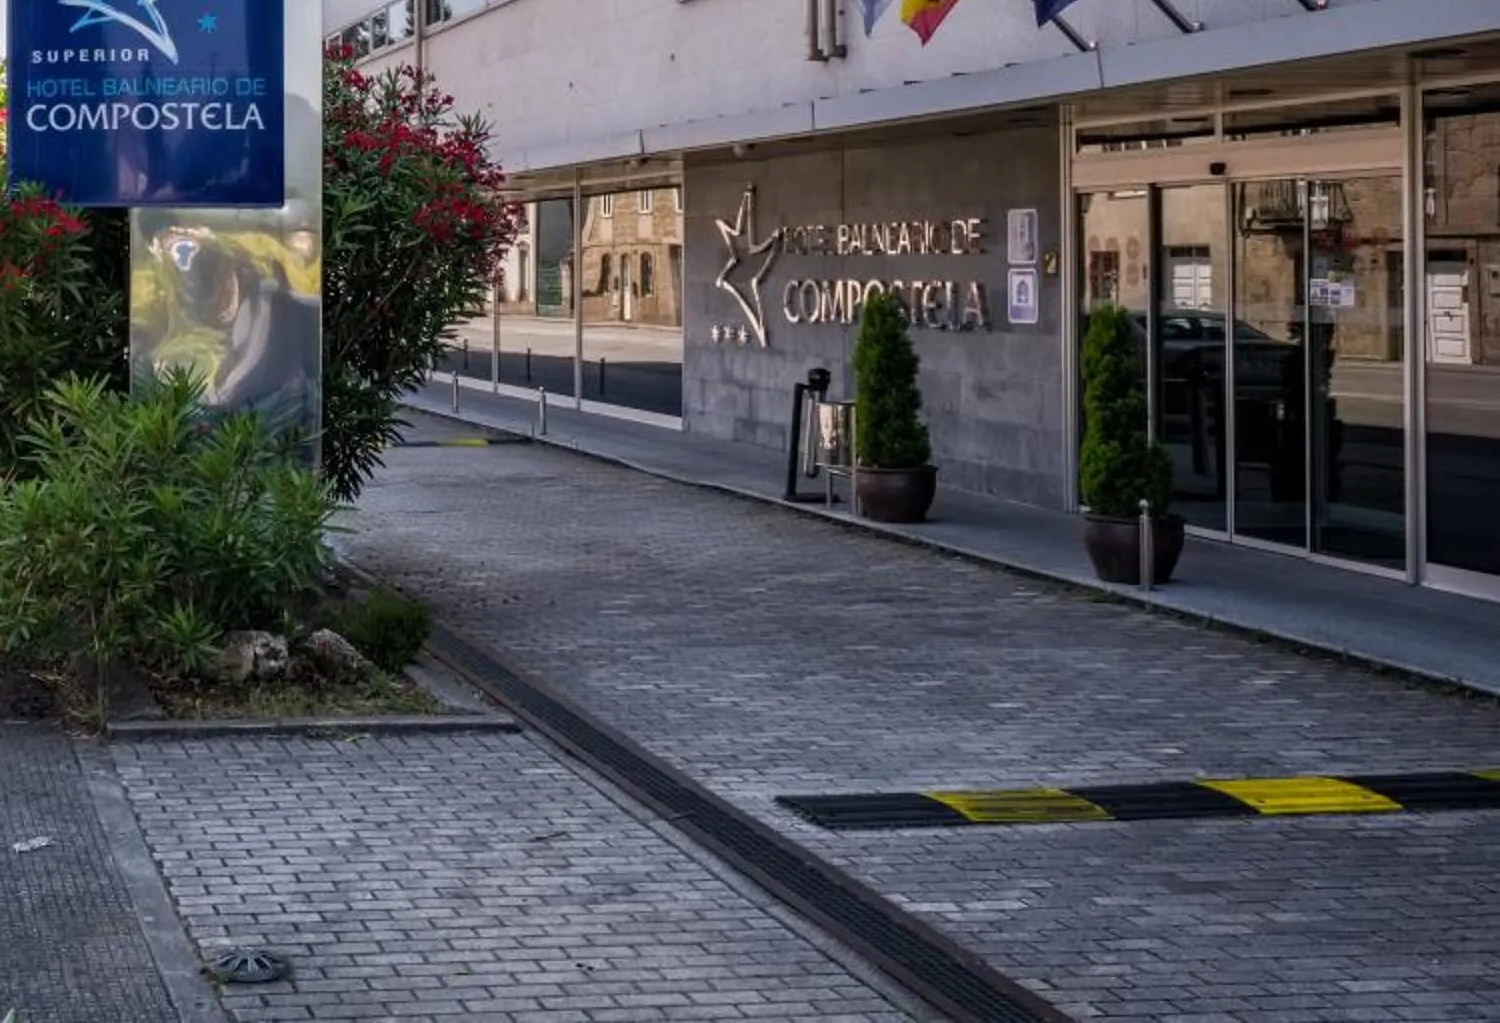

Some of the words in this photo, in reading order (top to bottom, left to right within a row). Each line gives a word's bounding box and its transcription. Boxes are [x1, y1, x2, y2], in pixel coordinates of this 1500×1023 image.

[31, 48, 149, 64] SUPERIOR
[27, 78, 95, 98] HOTEL
[103, 78, 228, 96] BALNEARIO
[235, 78, 266, 96] DE
[26, 102, 265, 132] COMPOSTELA
[951, 218, 981, 254] DE
